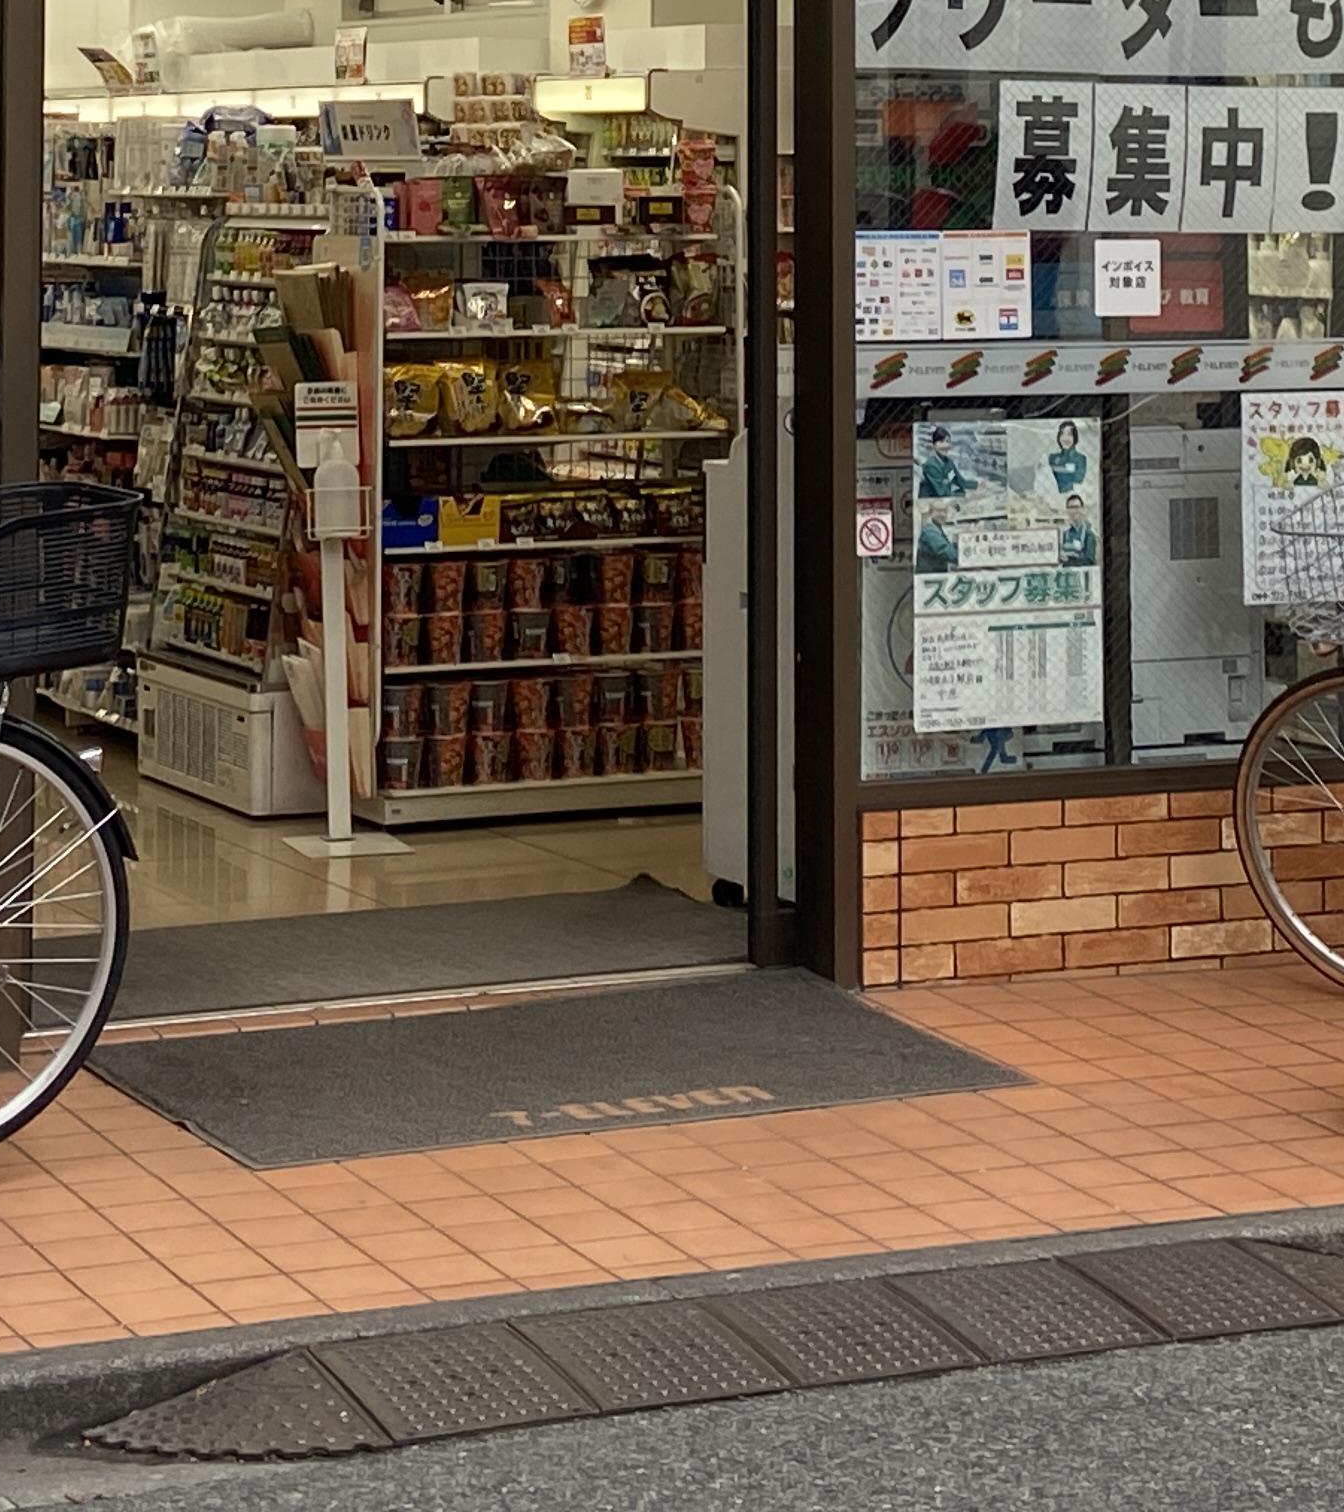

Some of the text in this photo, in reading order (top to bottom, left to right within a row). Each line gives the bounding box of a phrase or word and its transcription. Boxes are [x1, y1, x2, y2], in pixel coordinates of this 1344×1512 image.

[1100, 259, 1155, 273] インボイス
[1109, 275, 1147, 289] 対象店
